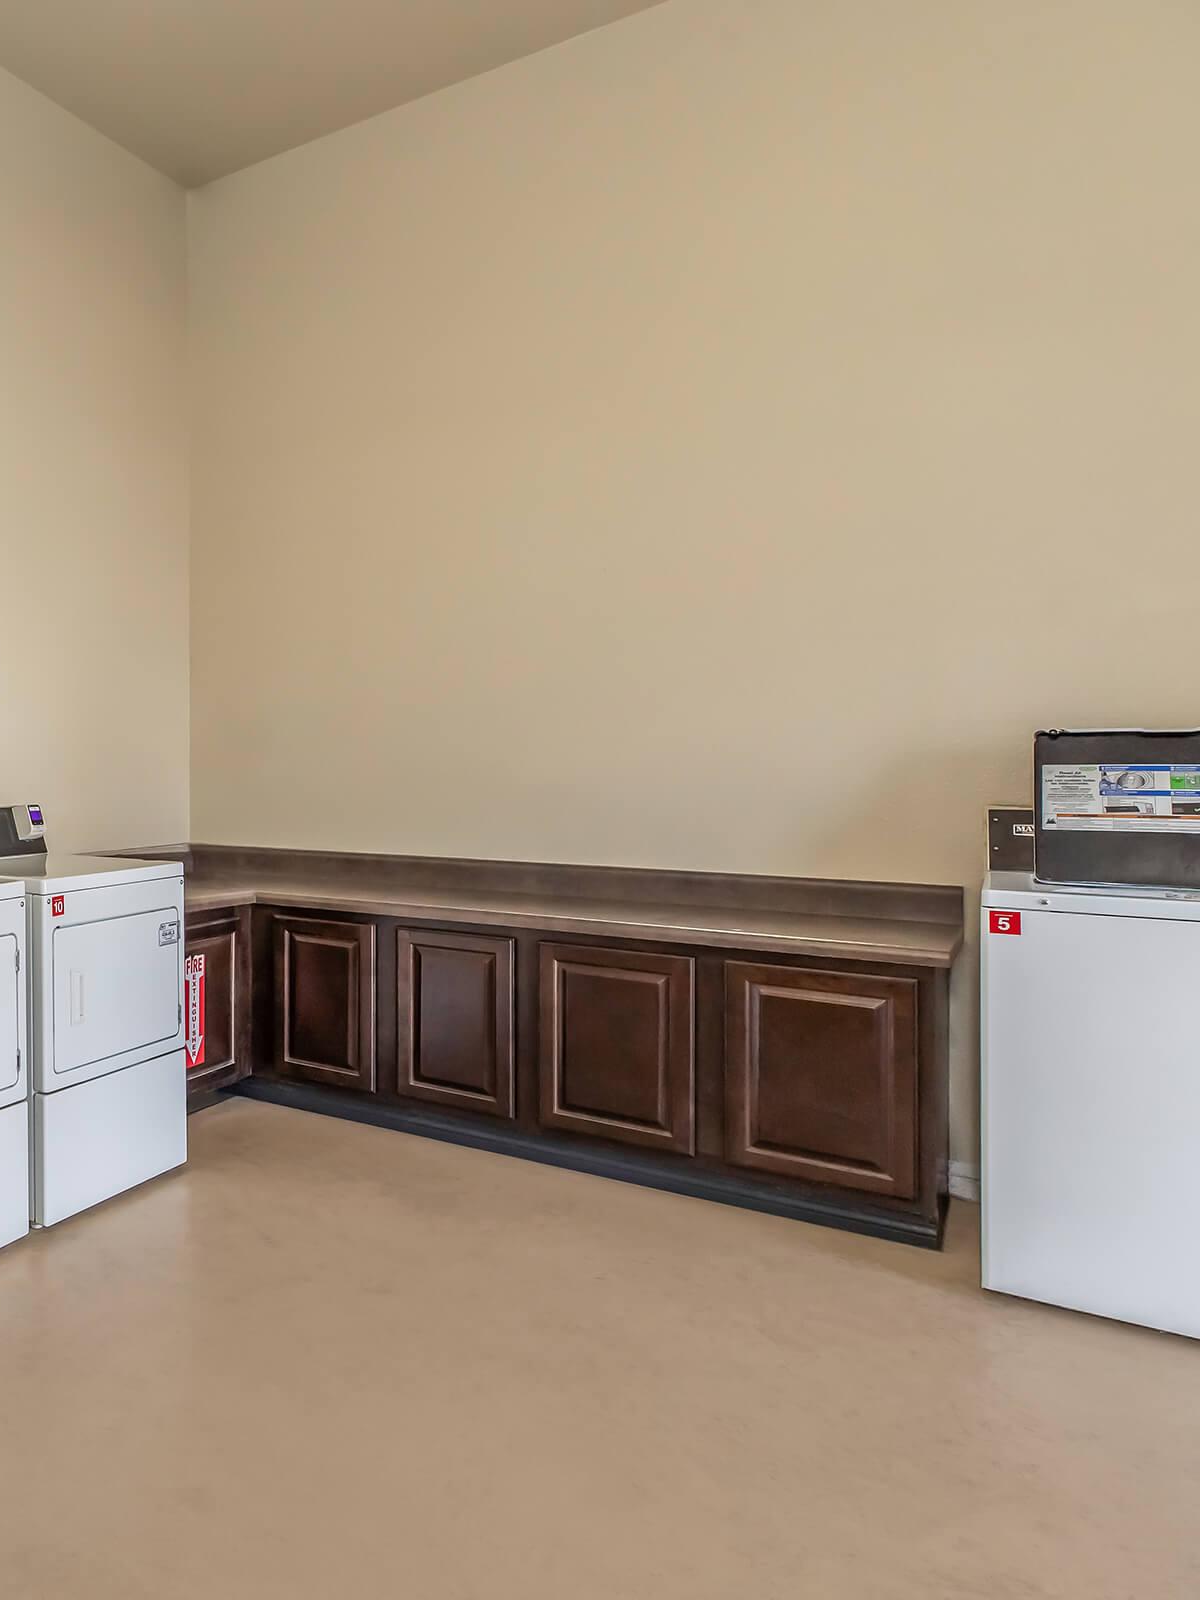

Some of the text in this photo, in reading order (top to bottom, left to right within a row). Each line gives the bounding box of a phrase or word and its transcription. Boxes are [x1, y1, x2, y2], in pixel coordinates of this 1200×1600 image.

[54, 902, 62, 912] 10
[998, 918, 1010, 930] 5
[187, 958, 202, 975] FIRE
